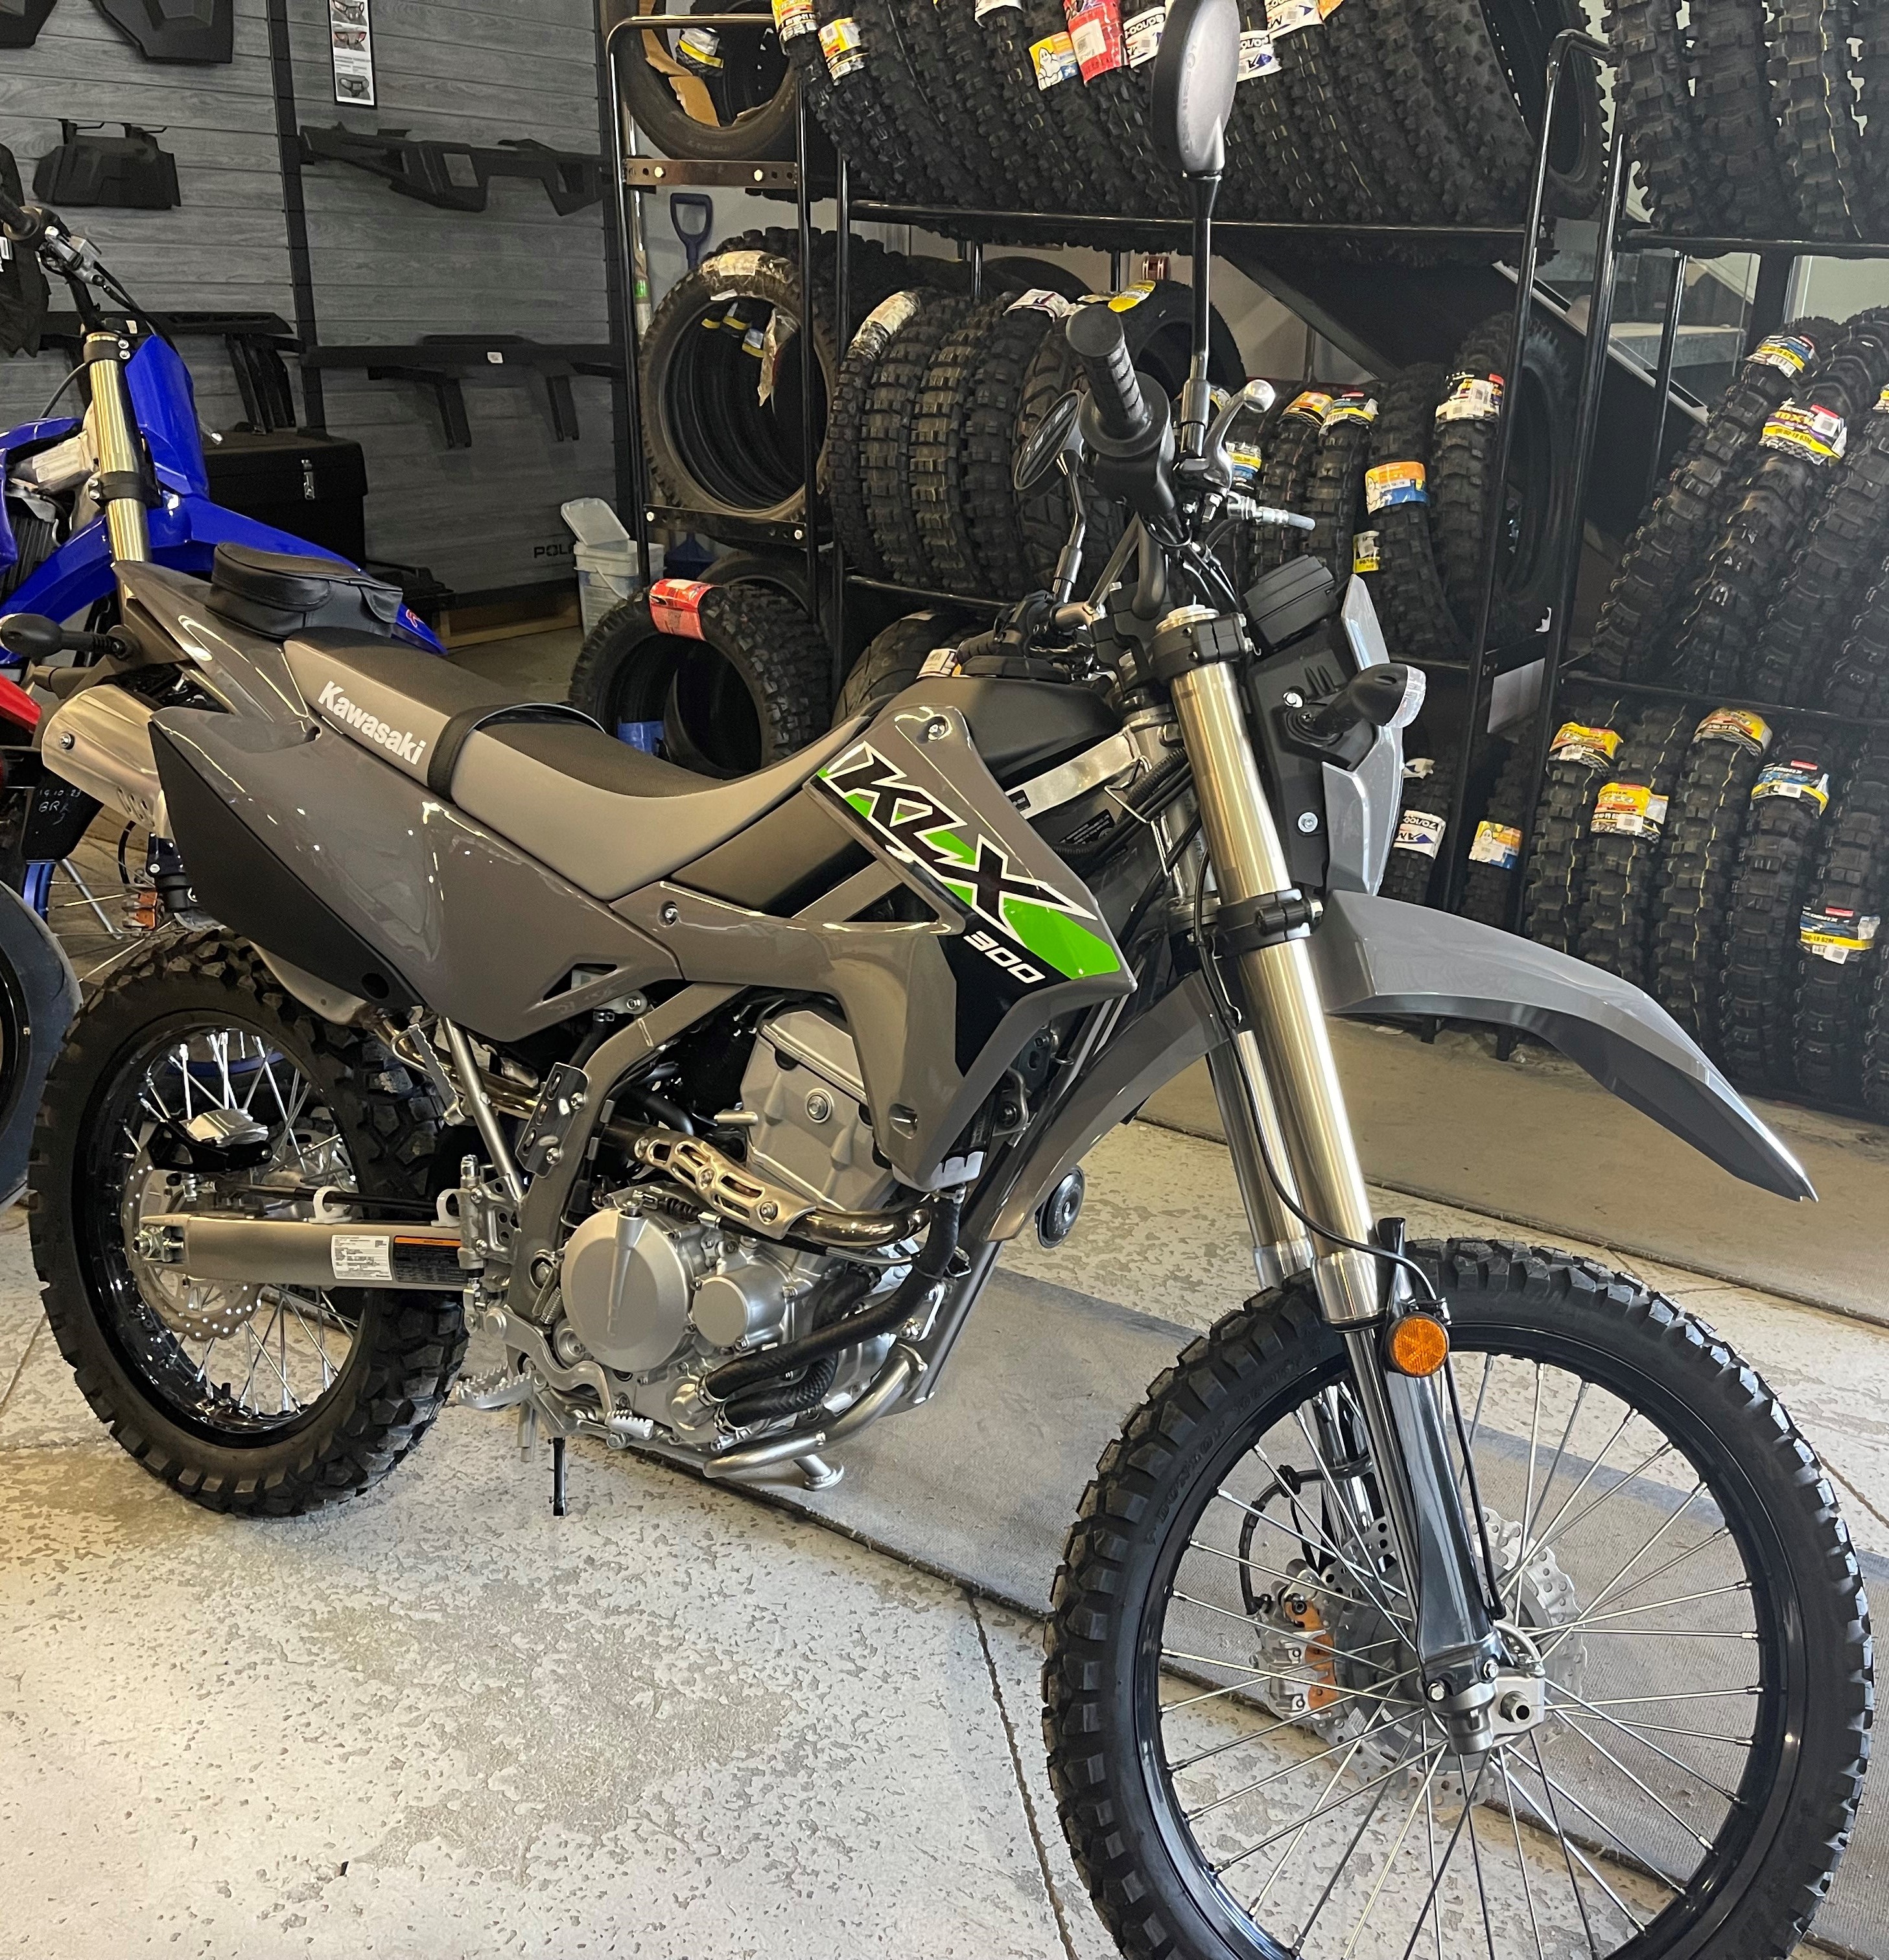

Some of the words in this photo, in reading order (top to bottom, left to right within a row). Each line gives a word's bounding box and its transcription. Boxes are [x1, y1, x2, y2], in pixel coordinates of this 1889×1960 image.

[318, 681, 427, 765] Kawasaki
[822, 740, 1098, 948] KLX
[963, 930, 1046, 984] 300
